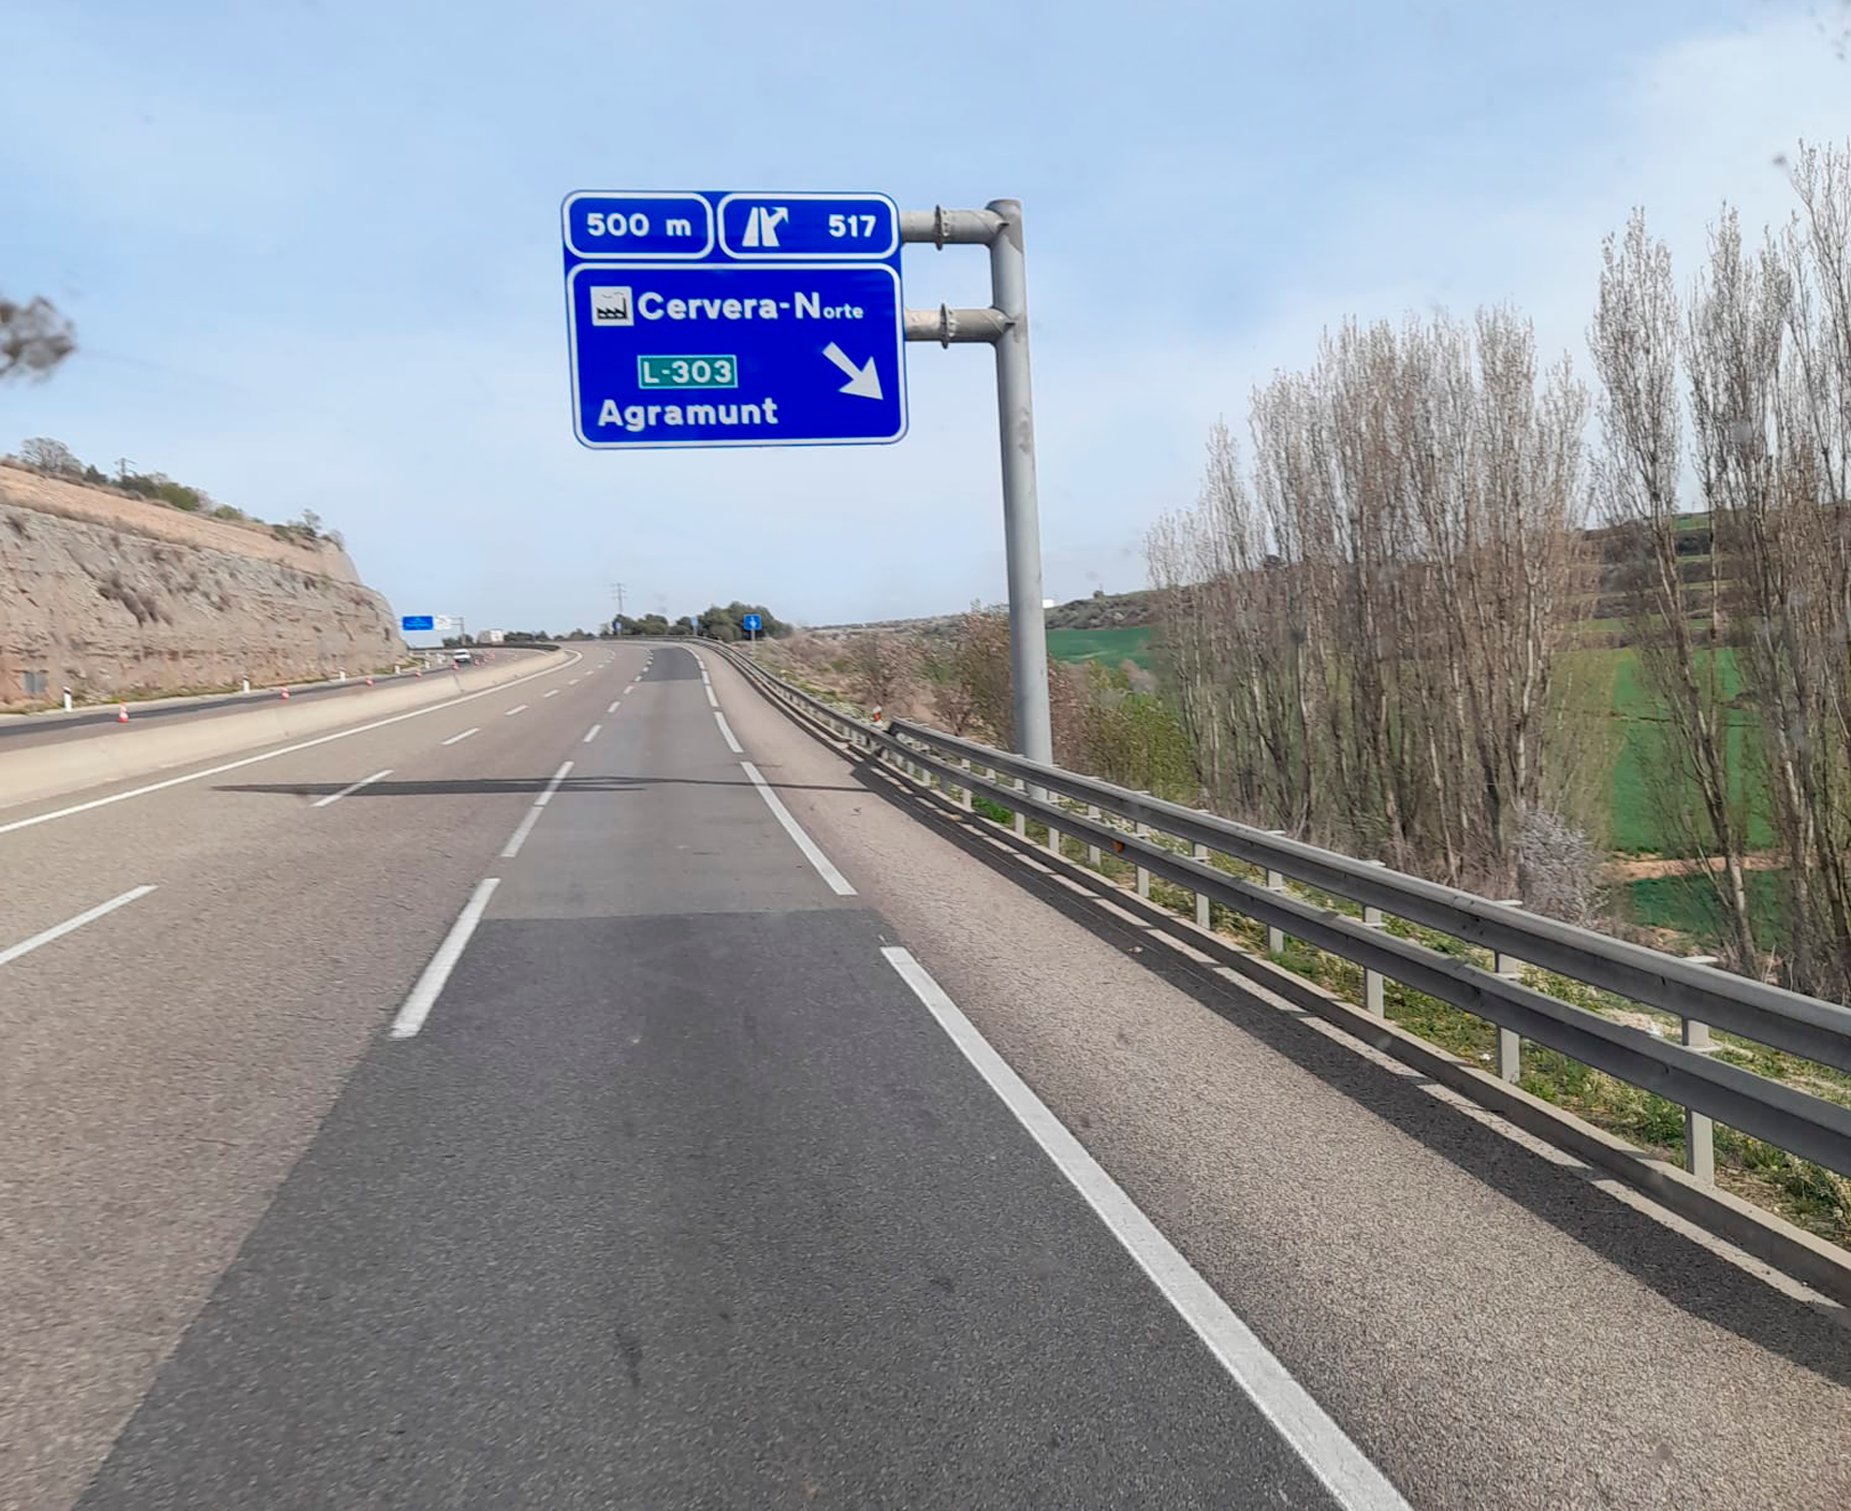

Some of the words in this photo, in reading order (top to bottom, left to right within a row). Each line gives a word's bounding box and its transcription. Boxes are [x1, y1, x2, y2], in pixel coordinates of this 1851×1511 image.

[587, 213, 649, 237] 500
[665, 218, 692, 237] m
[828, 214, 877, 238] 517
[637, 292, 864, 320] Cervera-Norte
[643, 360, 733, 384] L-303
[598, 397, 779, 432] Agramunt
